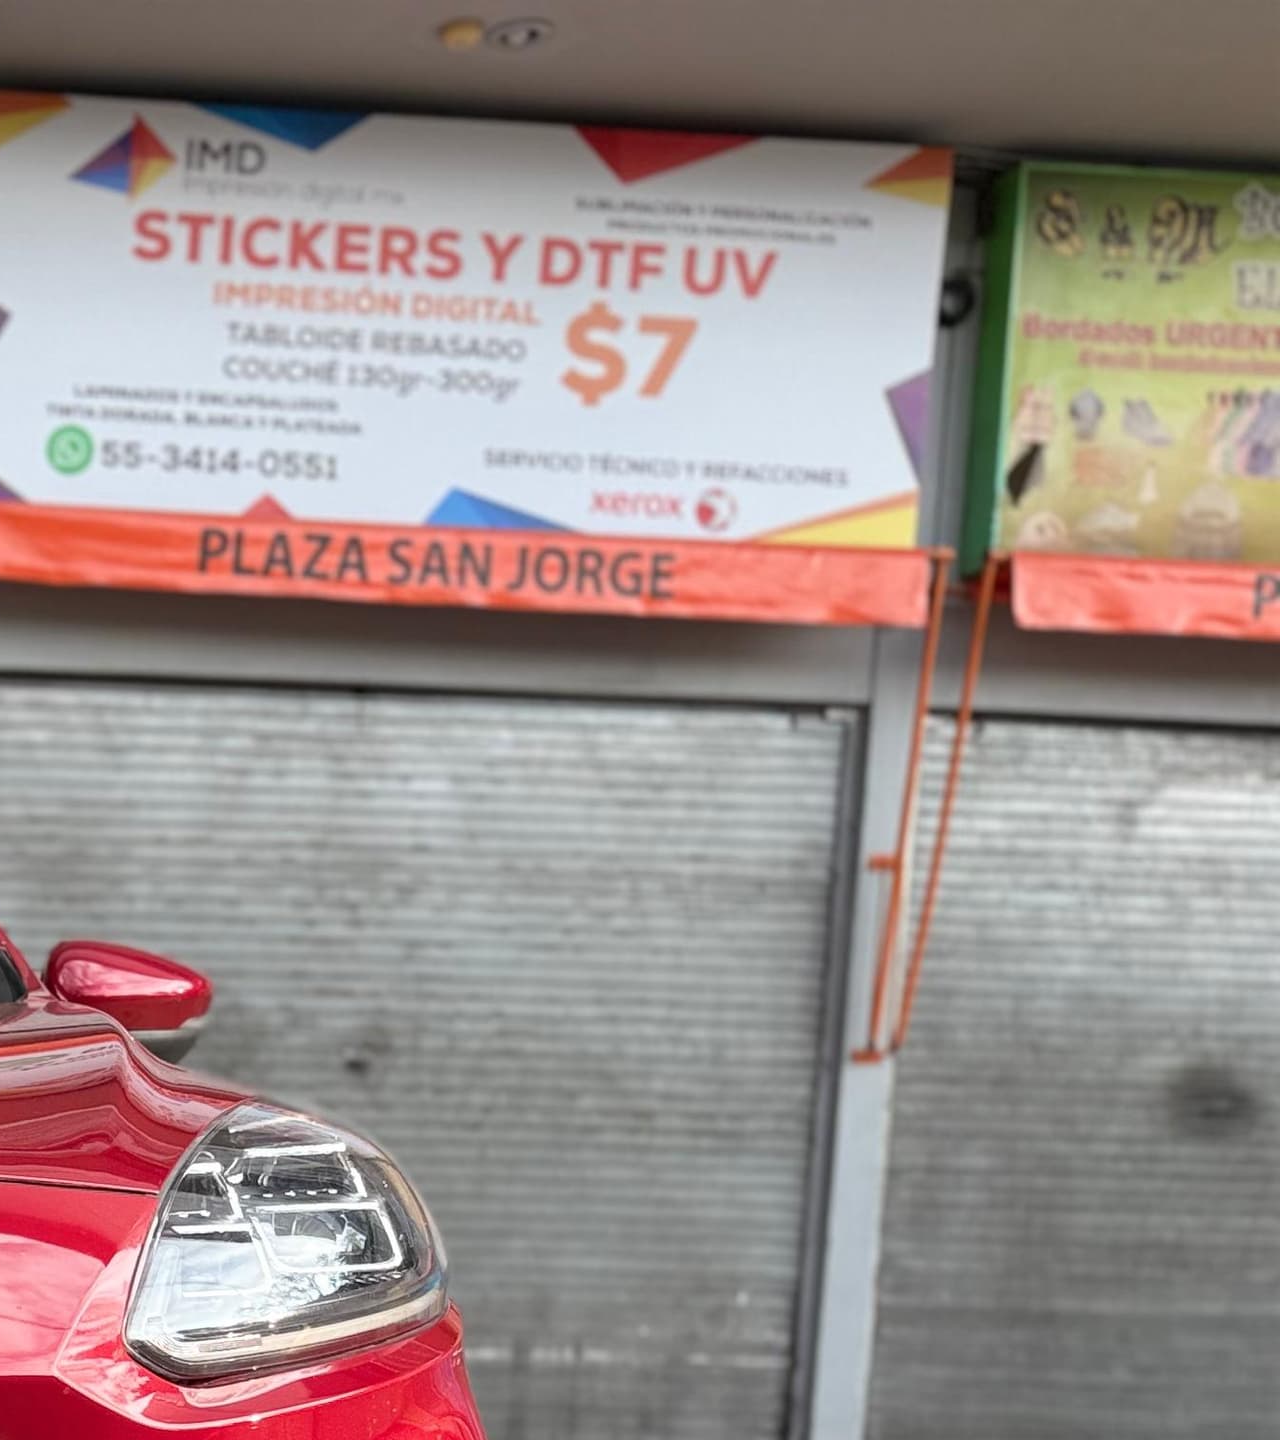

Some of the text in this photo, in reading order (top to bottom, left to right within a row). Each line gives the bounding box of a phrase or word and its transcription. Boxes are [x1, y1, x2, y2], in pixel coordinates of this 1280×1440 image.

[185, 138, 267, 176] IMD
[132, 209, 779, 299] STICKERS Y DTF UV
[213, 281, 542, 327] IMPRESIÓN DIGITAL
[226, 321, 528, 363] TABLOIDE REBASADO
[559, 300, 699, 407] $7
[221, 354, 339, 388] COUCHÉ
[100, 439, 339, 481] 55-3414-0551
[590, 489, 684, 521] xerox
[197, 526, 676, 600] PLAZA SAN JORGE
